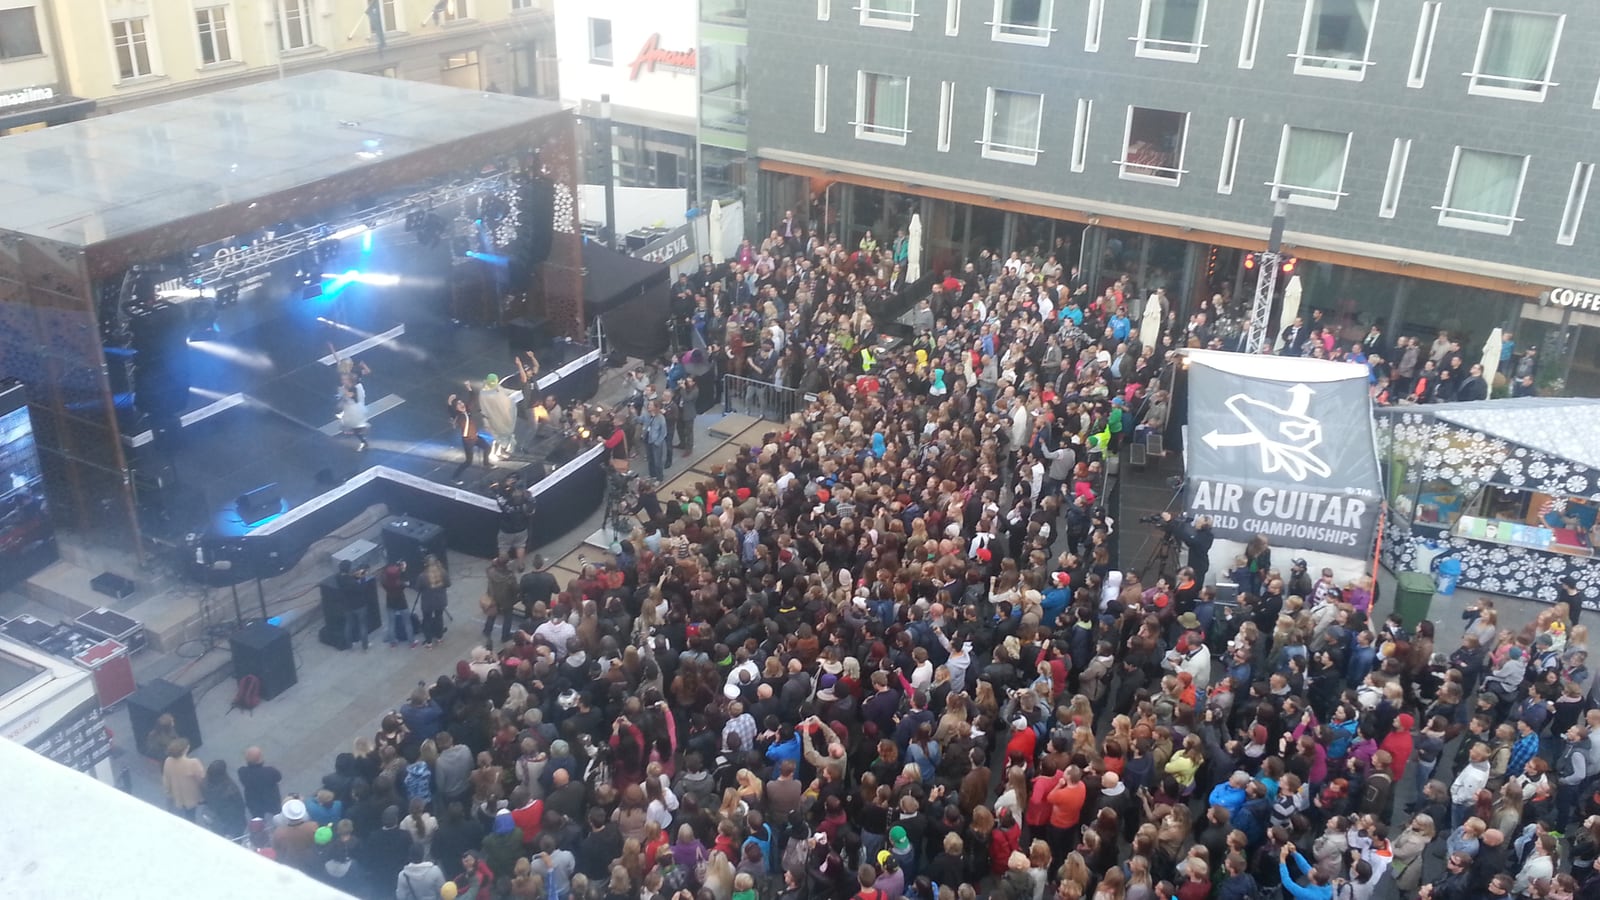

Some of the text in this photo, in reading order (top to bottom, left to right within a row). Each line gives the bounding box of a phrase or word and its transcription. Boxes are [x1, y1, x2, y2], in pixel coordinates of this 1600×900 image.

[1550, 287, 1600, 311] COFFE
[1191, 481, 1366, 529] AIR GUITAR
[1242, 518, 1358, 547] CHAMPIONSHIPS
